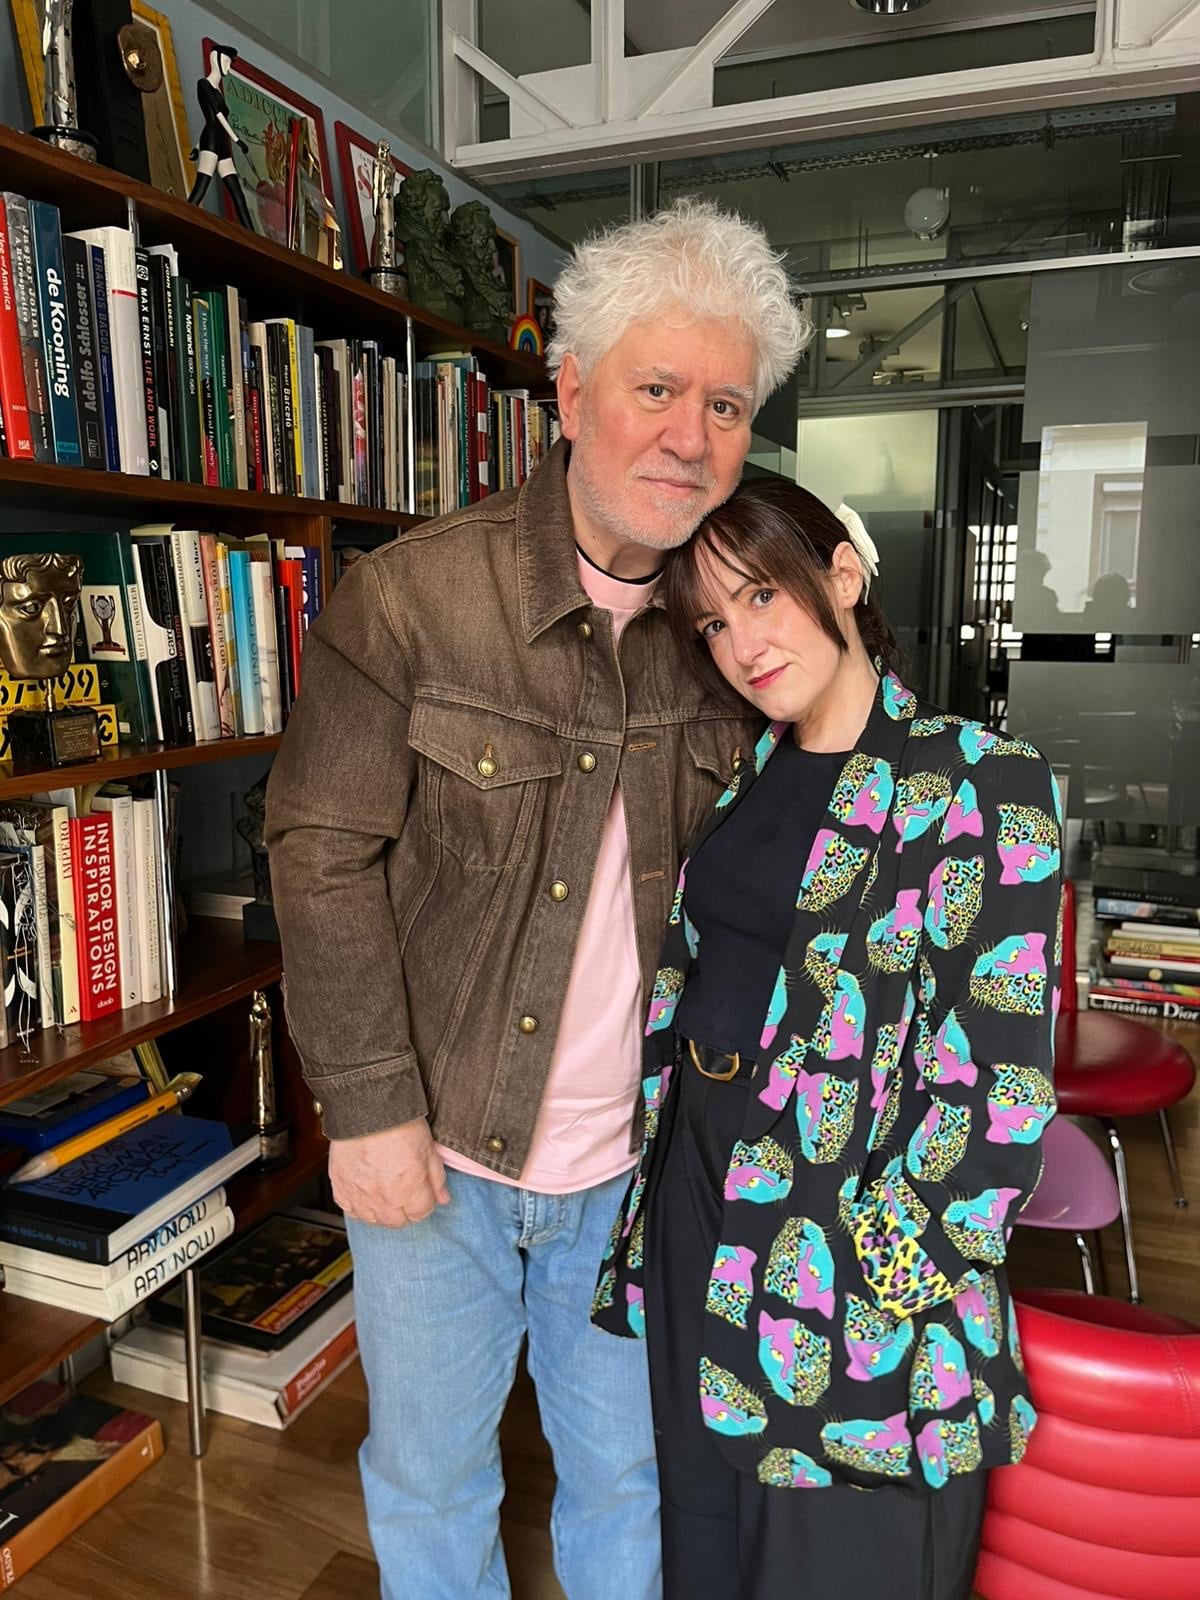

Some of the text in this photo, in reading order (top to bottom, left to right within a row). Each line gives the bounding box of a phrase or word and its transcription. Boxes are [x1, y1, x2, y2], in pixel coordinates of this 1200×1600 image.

[1, 268, 12, 310] America
[17, 248, 28, 322] Retrospective
[21, 225, 39, 338] Jasper Johns
[94, 257, 106, 308] FRANCIS
[47, 267, 70, 399] de Kooning
[76, 283, 91, 356] Schlosser
[99, 313, 110, 354] BACON
[166, 291, 174, 348] BALDESSARI
[186, 314, 194, 355] Morandi
[80, 361, 97, 412] Adolfo
[140, 287, 156, 447] MAX ERNST LIFE AND WORK
[283, 388, 292, 428] Barceló
[170, 659, 182, 700] pierre
[83, 825, 104, 994] INSPIRATIONS
[97, 822, 117, 990] INTERIOR DESIGN
[1090, 999, 1200, 1020] Christian Dior
[134, 1226, 215, 1298] ART NOW
